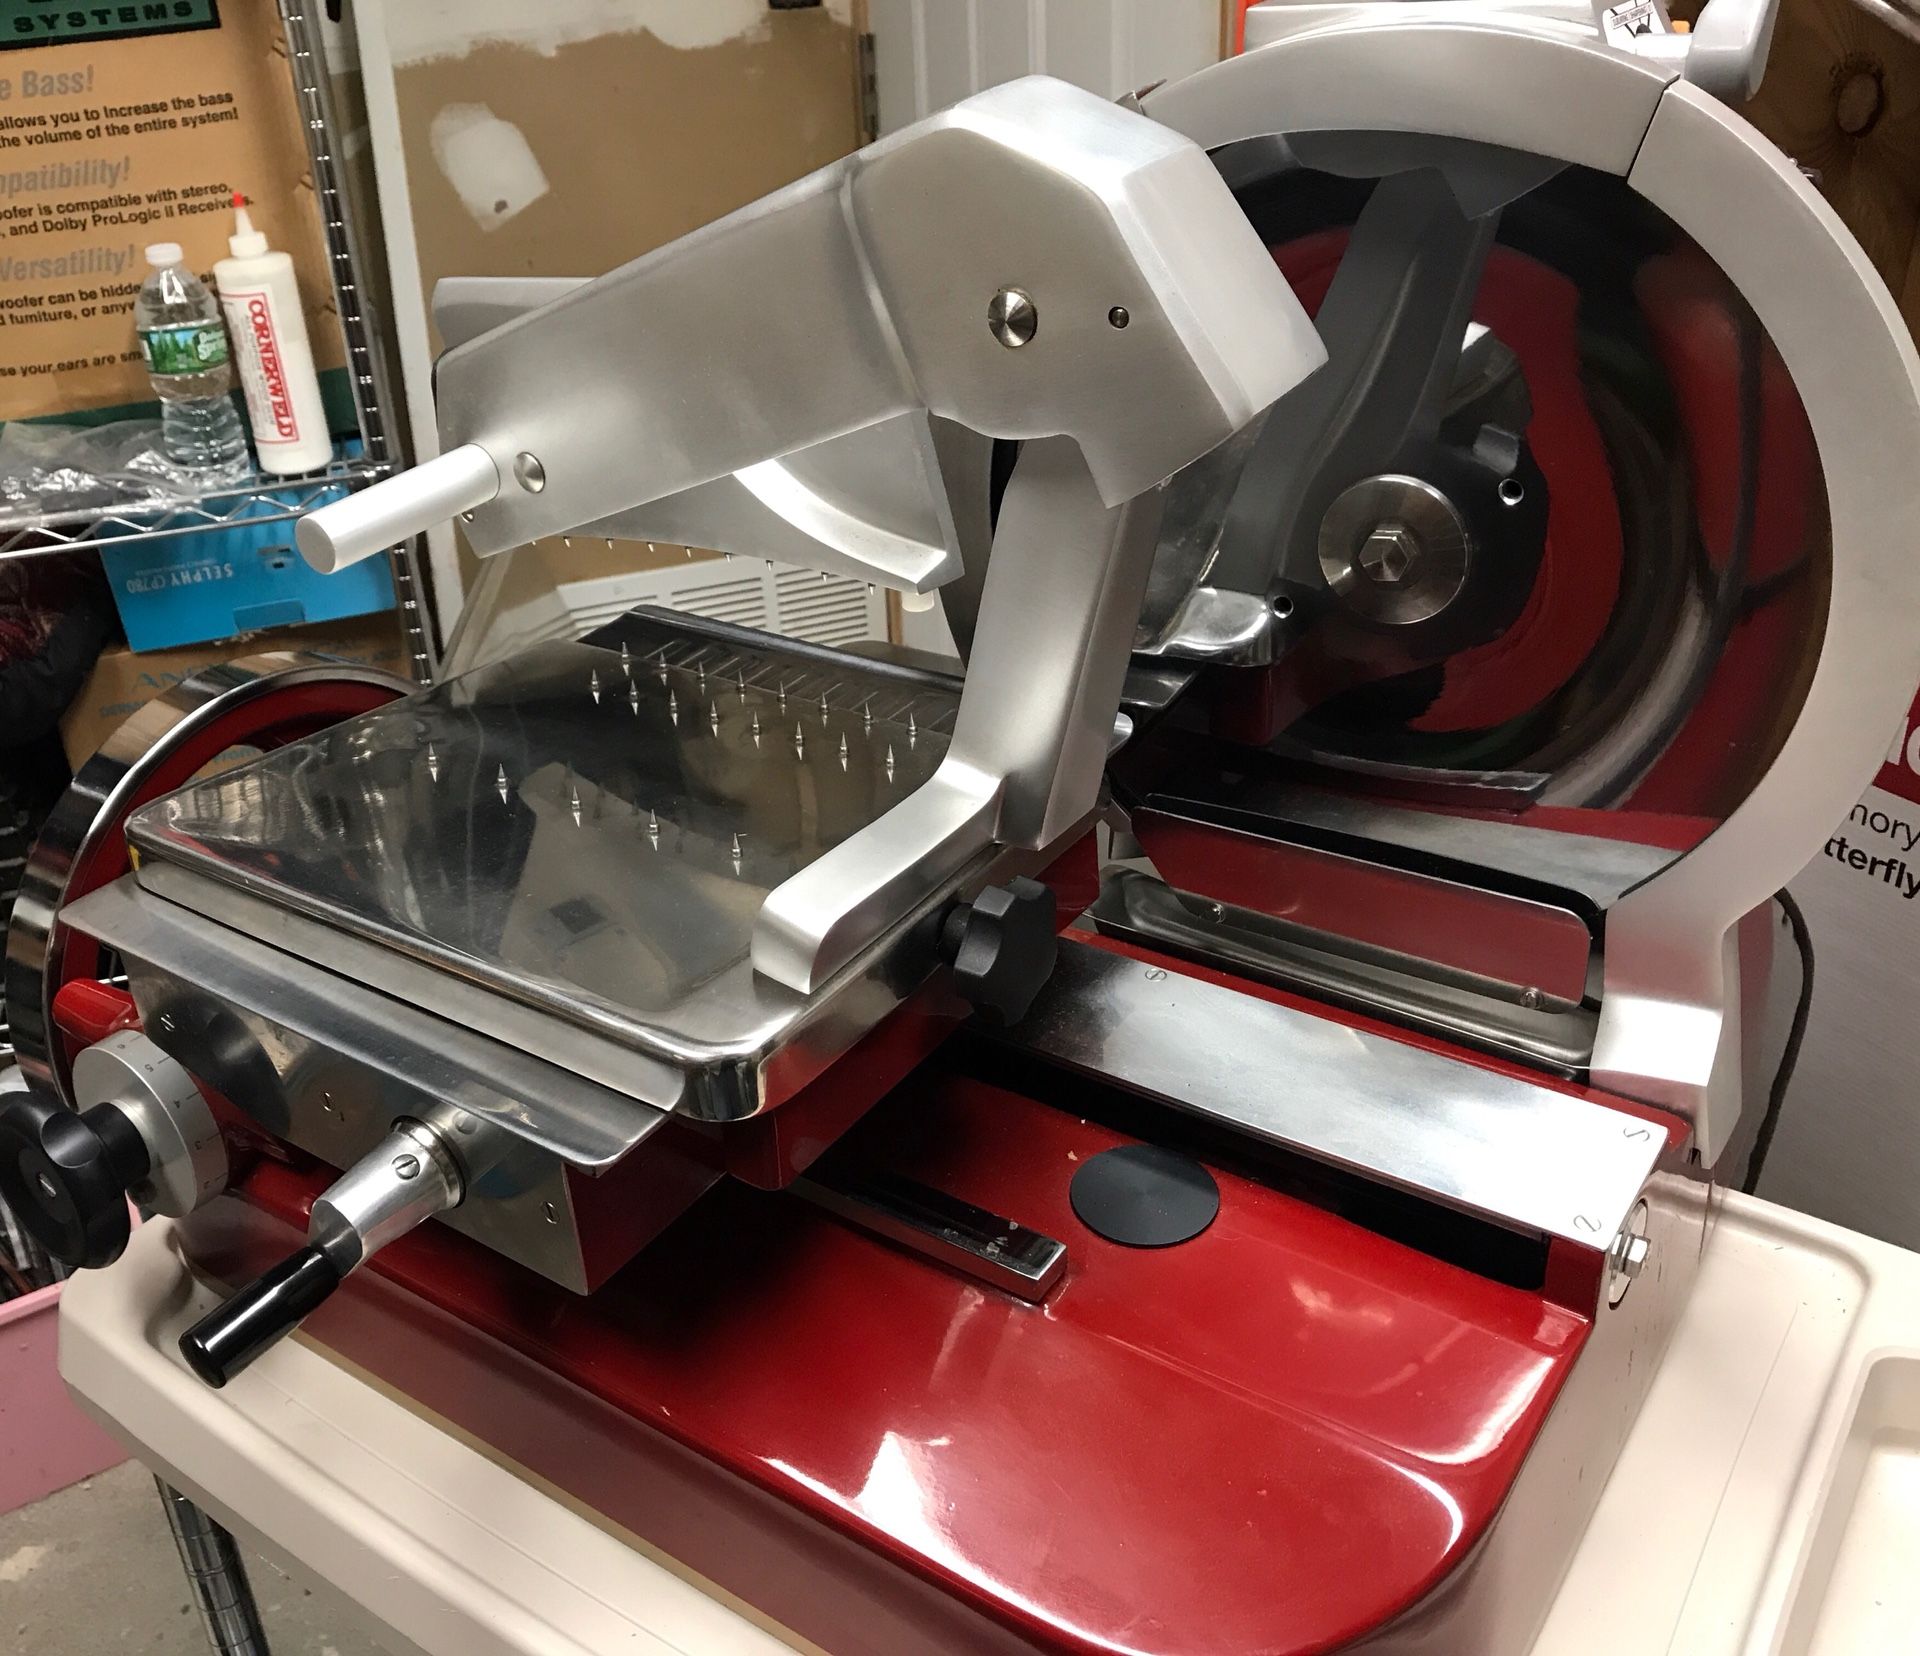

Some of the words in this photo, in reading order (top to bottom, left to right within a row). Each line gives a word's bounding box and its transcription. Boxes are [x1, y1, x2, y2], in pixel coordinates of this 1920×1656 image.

[13, 1, 193, 33] SYSTEMS
[22, 63, 94, 99] Bass!
[0, 114, 47, 131] allows
[50, 111, 80, 128] you
[83, 108, 100, 121] to
[171, 96, 196, 111] the
[197, 92, 234, 107] bass
[24, 130, 82, 146] volume
[86, 125, 102, 139] of
[104, 123, 130, 137] the
[134, 117, 177, 134] entire
[181, 106, 239, 129] system!
[9, 220, 39, 237] and
[42, 217, 88, 232] Dolby
[92, 207, 162, 227] ProLogic
[177, 195, 254, 217] Receives.
[37, 202, 53, 216] is
[56, 193, 142, 214] compatible
[145, 188, 178, 204] with
[47, 291, 76, 306] can
[79, 288, 98, 302] be
[100, 282, 141, 298] hidde
[9, 308, 78, 325] furniture,
[81, 306, 97, 318] or
[20, 363, 53, 378] your
[57, 357, 89, 373] ears
[92, 354, 116, 368] are
[248, 299, 294, 438] CORNERWELD
[170, 562, 234, 587] SELPHY
